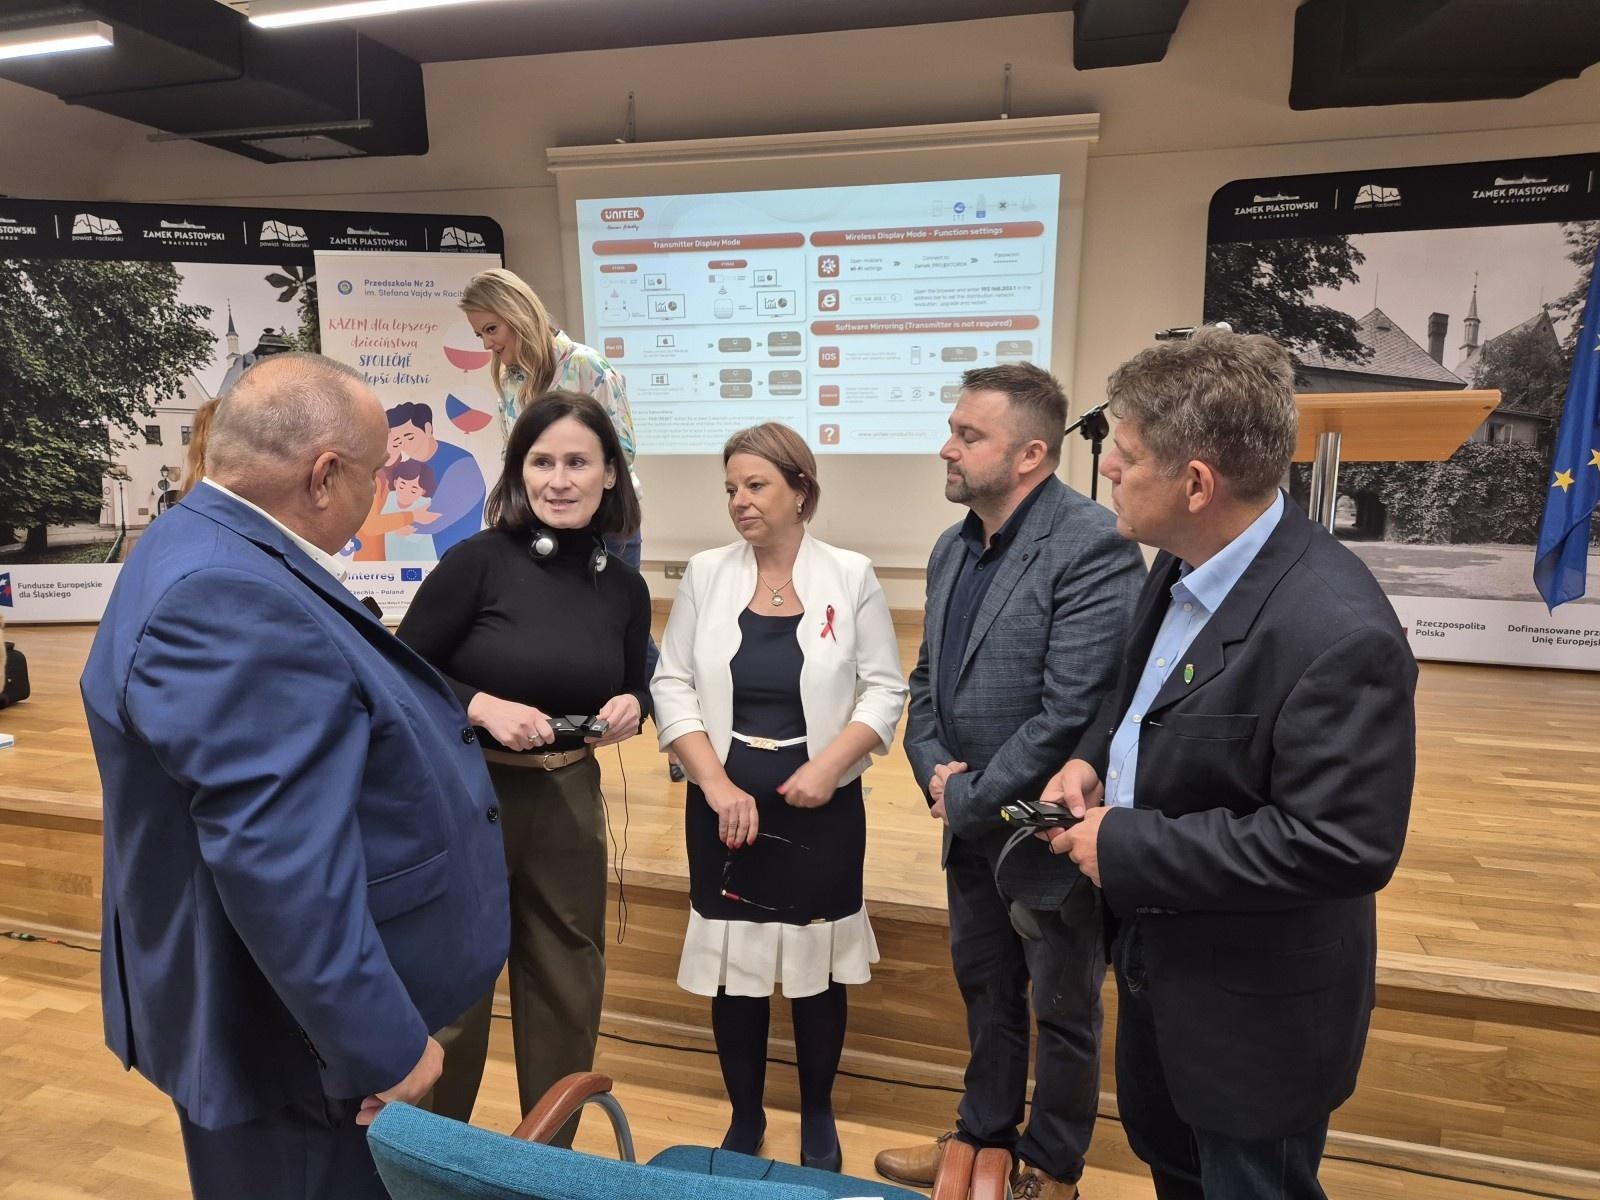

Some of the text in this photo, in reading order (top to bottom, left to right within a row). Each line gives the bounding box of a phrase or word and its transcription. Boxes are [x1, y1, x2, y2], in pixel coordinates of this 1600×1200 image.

[1472, 184, 1569, 199] ZAMEK PIASTOWSKI
[605, 209, 640, 219] UNITEK
[1234, 202, 1319, 215] ZAMEK PIASTOWSKI
[143, 230, 225, 241] ZAMEK PIASTOWSKI
[845, 233, 876, 241] Wireless
[877, 232, 905, 241] Display
[906, 230, 927, 238] Mode
[934, 228, 969, 237] Function
[970, 226, 1003, 236] settings
[329, 237, 408, 247] ZAMEK PIASTOWSKI
[652, 241, 693, 249] Transmitter
[695, 240, 720, 249] Display
[364, 279, 412, 287] Przedszkole
[425, 280, 434, 288] 23
[364, 288, 377, 296] im.
[378, 289, 409, 297] Stefana
[370, 317, 389, 331] dla
[392, 318, 439, 334] lepszego
[835, 322, 868, 331] Software
[870, 322, 904, 331] Mirroring
[905, 320, 951, 331] (Transmitter
[961, 320, 974, 328] not
[976, 319, 1012, 329] required)
[351, 335, 418, 349] dzieciństwa
[359, 352, 412, 368] SPOLEČNĚ
[392, 371, 432, 385] dětství
[57, 581, 102, 589] Europejskie
[33, 590, 72, 599] Śląskiego
[1416, 619, 1486, 630] Rzeczpospolita
[1416, 629, 1445, 637] Polska
[1507, 624, 1600, 637] Dofinansowane prz
[1532, 636, 1554, 645] Unię
